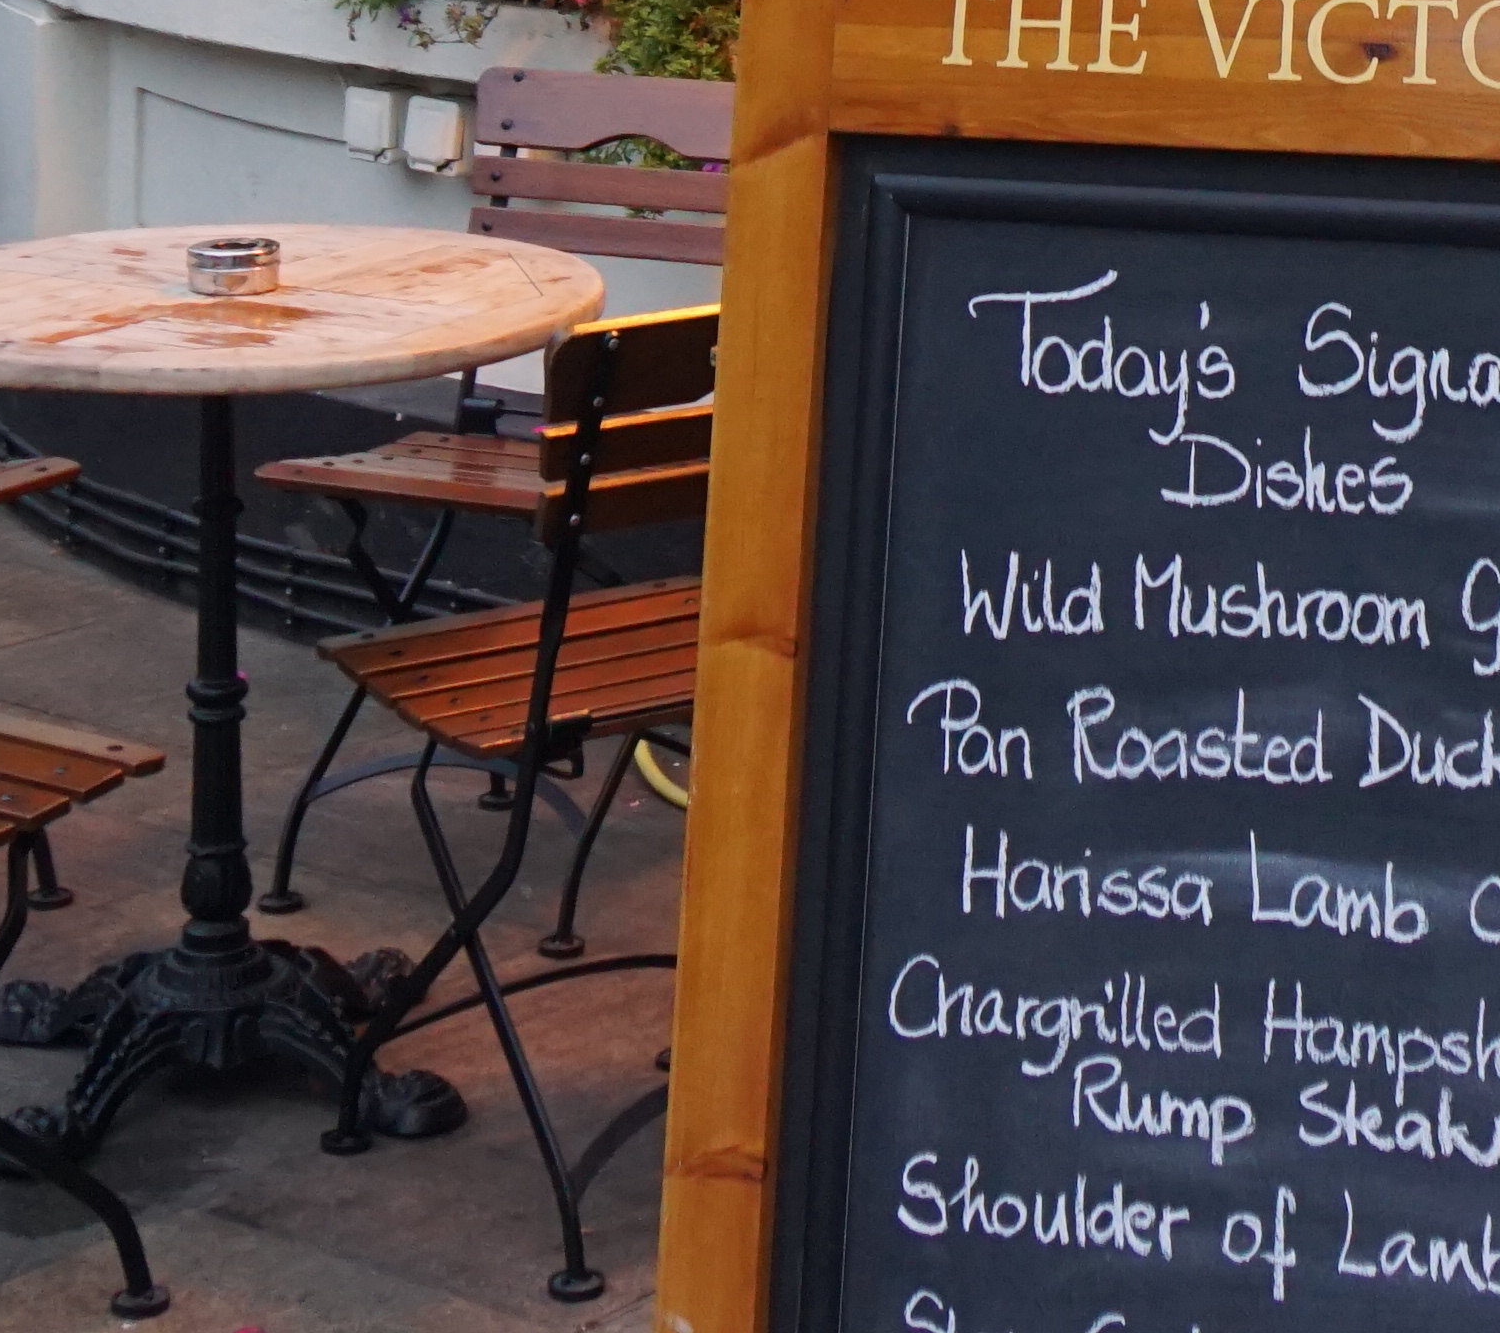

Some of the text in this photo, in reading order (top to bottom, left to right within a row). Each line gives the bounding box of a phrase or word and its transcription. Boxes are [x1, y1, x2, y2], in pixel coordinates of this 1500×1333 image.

[967, 269, 1235, 445] Today's
[1161, 425, 1414, 515] Dishes
[960, 546, 1104, 640] Wild
[1134, 554, 1430, 648] Mushroom
[906, 678, 1033, 780] Pan
[1066, 684, 1333, 786] Roasted
[961, 825, 1212, 926] Harissa
[1249, 830, 1429, 945] Lamb
[887, 954, 1222, 1078] Chargrilled
[1071, 1055, 1254, 1166] Rump
[898, 1153, 1190, 1260] Shoulder
[1220, 1187, 1296, 1301] of
